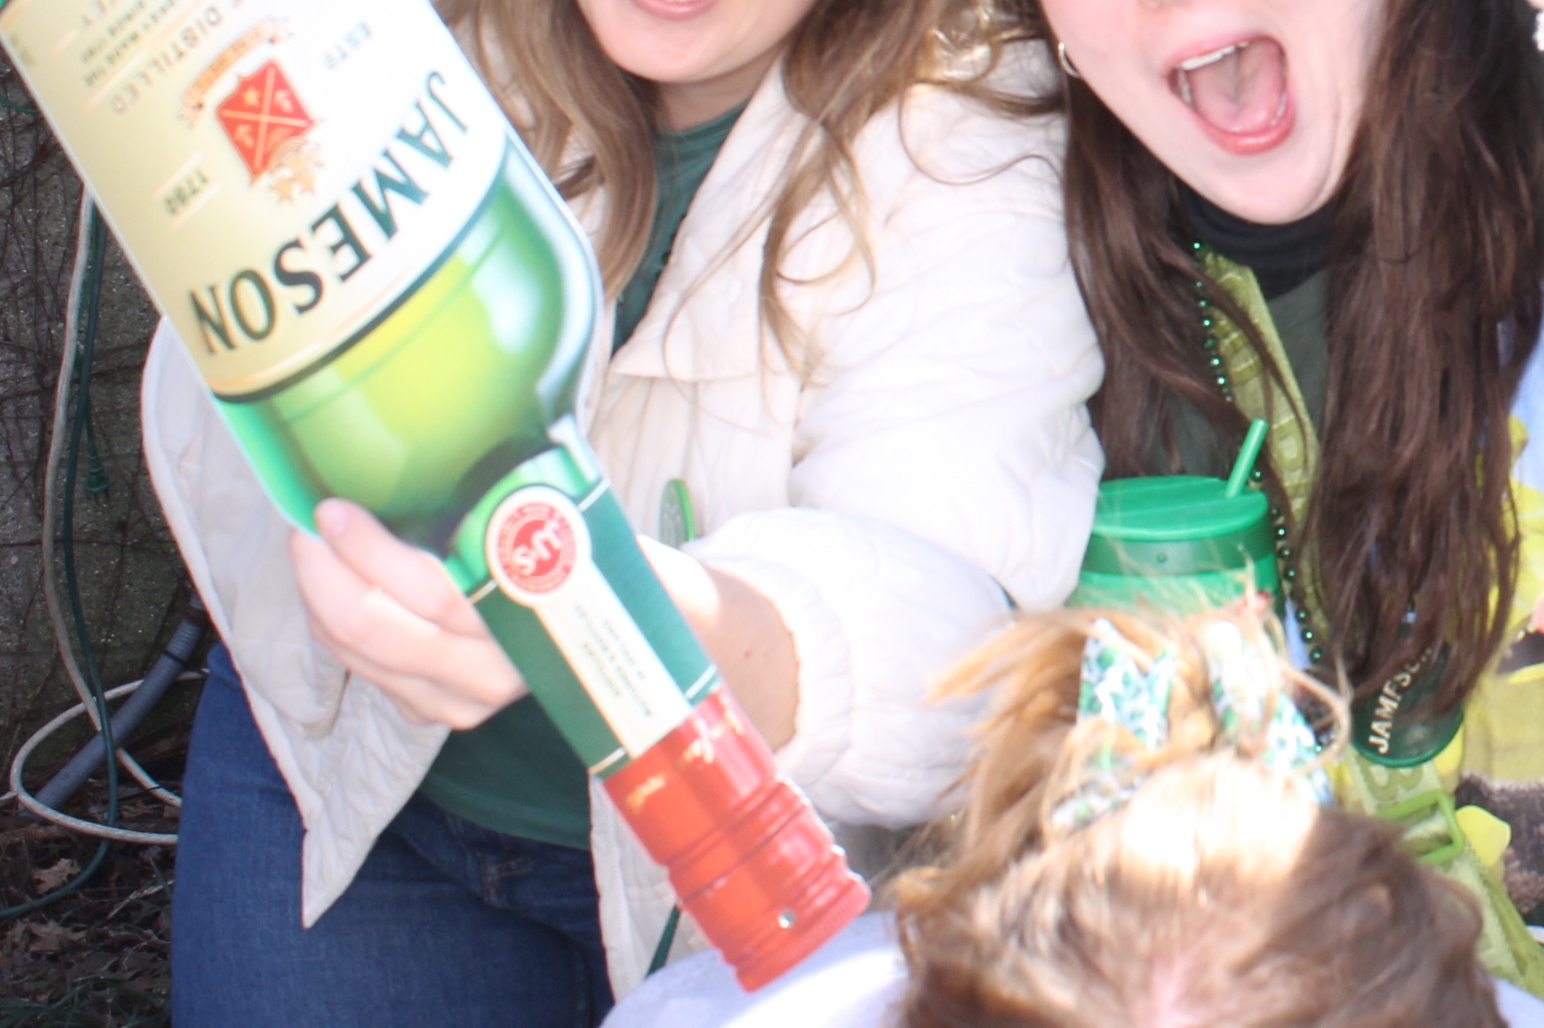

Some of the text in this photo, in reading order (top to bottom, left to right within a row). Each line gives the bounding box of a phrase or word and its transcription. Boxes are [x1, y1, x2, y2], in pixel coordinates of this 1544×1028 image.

[105, 2, 224, 119] DISTILLED
[160, 168, 209, 217] 1780
[189, 71, 468, 355] JAMESON
